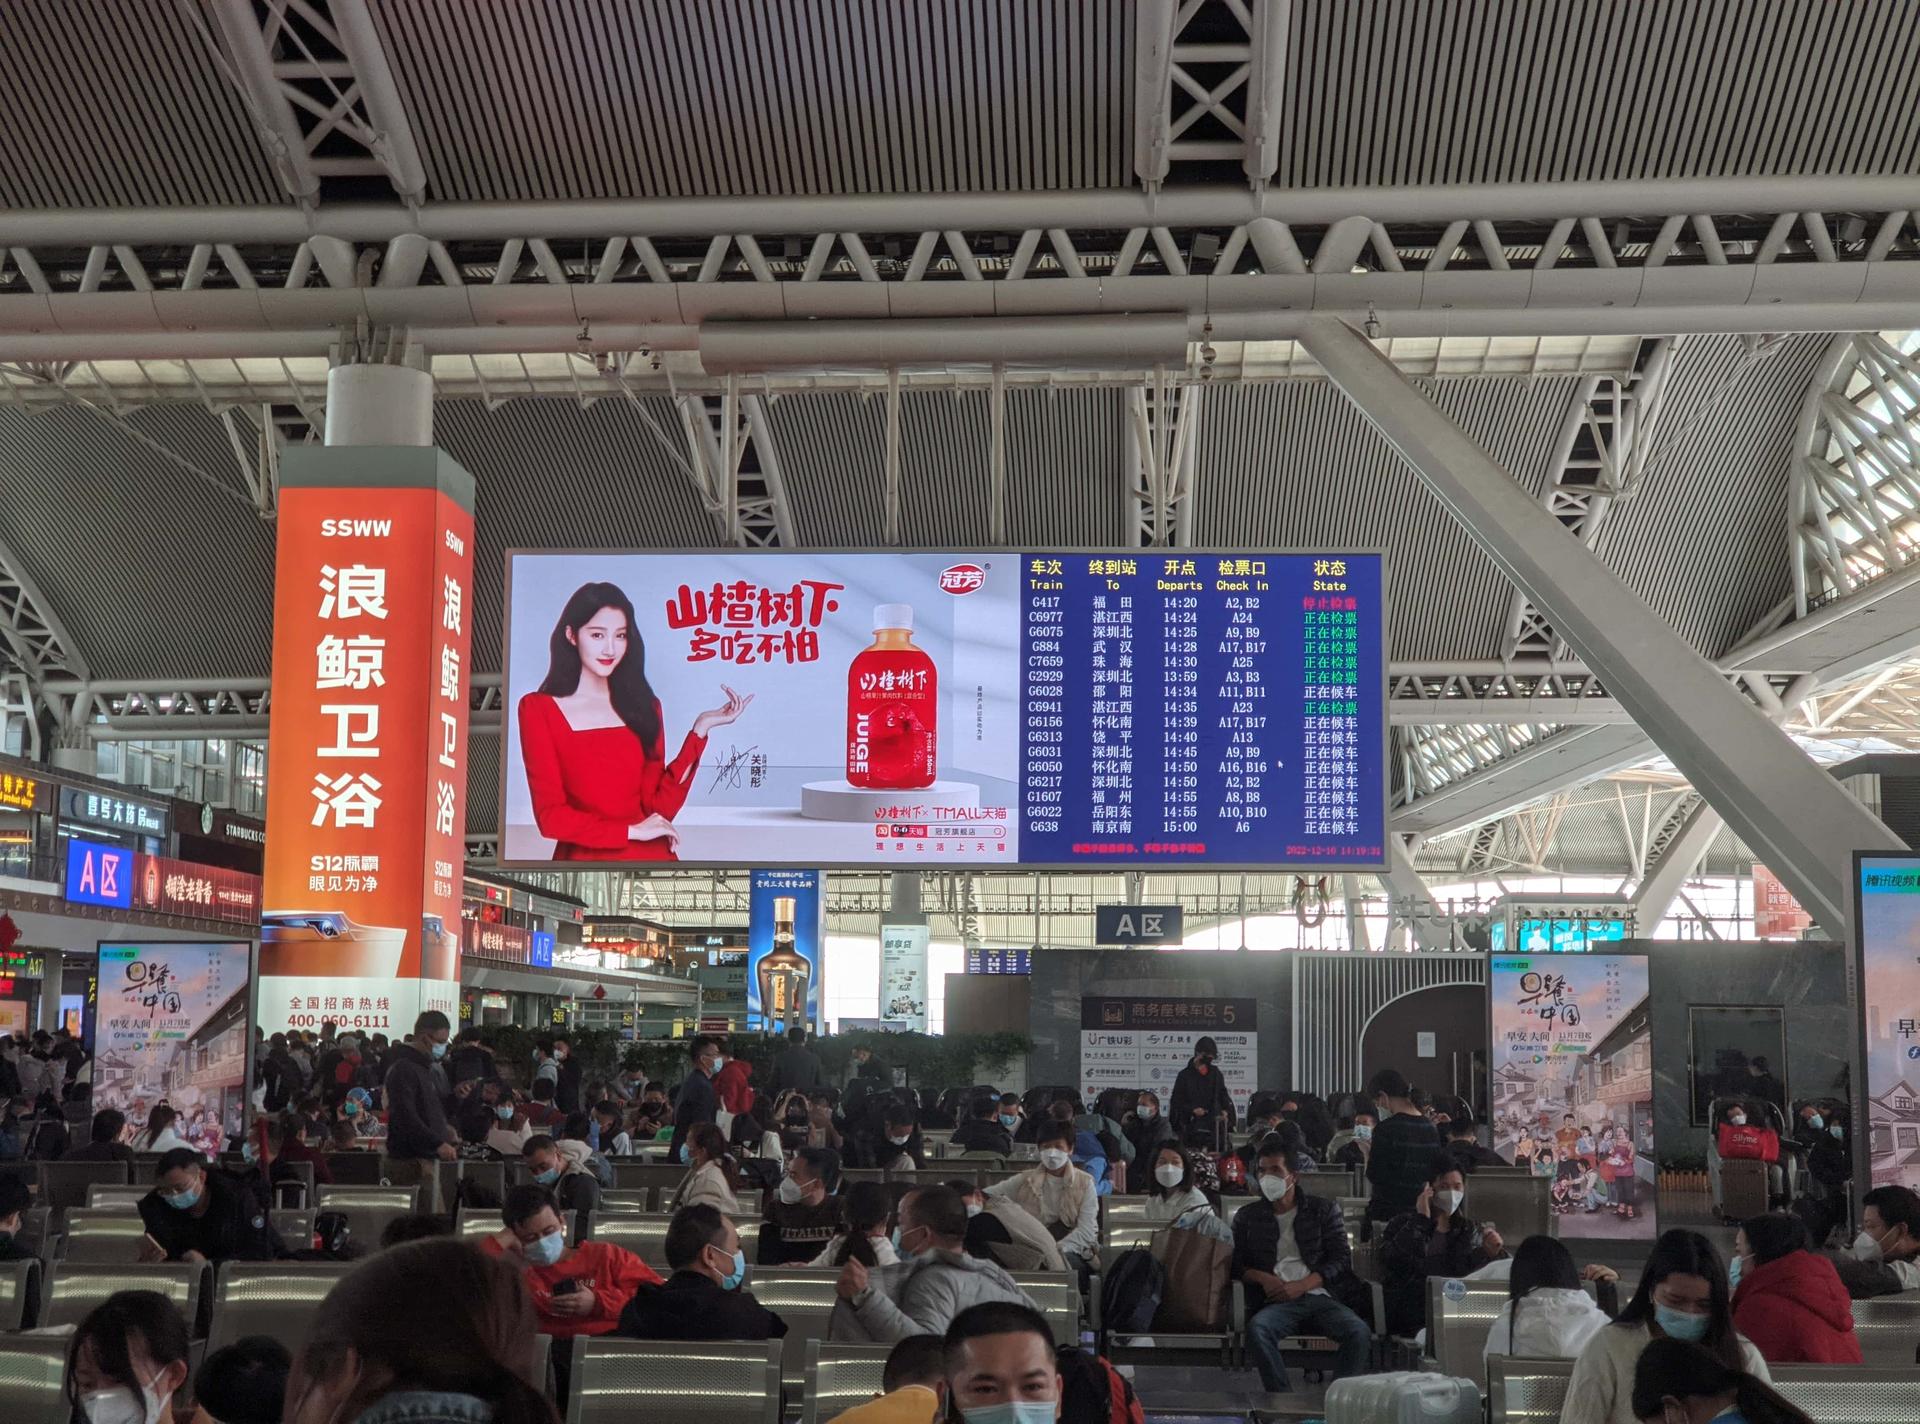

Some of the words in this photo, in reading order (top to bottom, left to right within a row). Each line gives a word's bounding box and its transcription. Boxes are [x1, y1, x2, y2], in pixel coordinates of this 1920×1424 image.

[321, 519, 391, 537] SSWW
[445, 529, 464, 557] SSWW
[1031, 559, 1062, 575] 车次
[1089, 560, 1136, 575] 终到站
[1164, 560, 1196, 575] 开点
[1219, 560, 1265, 576] 检票口
[1314, 560, 1346, 576] 状态
[941, 571, 983, 588] 冠芳
[1031, 580, 1062, 589] Train
[1107, 580, 1119, 589] To
[1217, 580, 1249, 590] Check
[1257, 581, 1268, 590] In
[1158, 580, 1202, 591] Departs
[1314, 581, 1346, 591] State
[666, 581, 844, 629] 山楂树下
[1033, 597, 1059, 607] G417
[1165, 598, 1197, 608] 14:20
[1029, 612, 1063, 622] C6977
[1165, 612, 1196, 622] 14:24
[1232, 613, 1252, 623] A24
[1304, 612, 1357, 627] 正在检票
[1029, 627, 1063, 636] G6075
[1165, 627, 1197, 637] 14:25
[1304, 626, 1357, 642] 正在检票
[687, 628, 819, 664] 多吃不怕
[1033, 641, 1059, 651] G884
[1165, 642, 1197, 652] 14:28
[1304, 641, 1357, 657] 正在检票
[1029, 656, 1063, 666] C7659
[1165, 657, 1197, 667] 14:30
[1233, 657, 1253, 667] A25
[1304, 656, 1357, 672] 正在检票
[1029, 671, 1063, 681] G2929
[1165, 671, 1197, 681] 13:59
[1304, 671, 1357, 687] 正在检票
[311, 564, 388, 828] 浪鲸卫浴
[1029, 686, 1062, 696] G6028
[1165, 686, 1197, 697] 14:34
[1304, 686, 1357, 702] 正在候车
[436, 573, 462, 837] 浪鲸卫浴
[1029, 702, 1061, 712] C6941
[1165, 702, 1197, 712] 14:35
[1232, 702, 1253, 712] A23
[1304, 701, 1357, 717] 正在检票
[1029, 717, 1062, 727] G6156
[1165, 717, 1197, 727] 14:39
[1304, 716, 1358, 729] 正在候车
[1028, 732, 1062, 742] G6313
[1165, 732, 1197, 742] 14:40
[1233, 732, 1253, 742] A13
[1304, 731, 1358, 744] 正在候车
[1028, 747, 1061, 756] G6031
[1165, 747, 1197, 757] 14:45
[1304, 746, 1358, 759] 正在候车
[751, 754, 761, 788] 关晓彤
[1028, 761, 1062, 772] G6050
[1165, 762, 1197, 772] 14:50
[1304, 761, 1358, 774] 正在候车
[0, 773, 35, 798] 特产汇
[1028, 777, 1062, 786] G6217
[1165, 777, 1197, 787] 14:50
[1304, 776, 1358, 789] 正在候车
[1028, 791, 1061, 801] G1607
[1164, 792, 1197, 802] 14:55
[1304, 791, 1358, 804] 正在候车
[1028, 807, 1061, 817] G6022
[1164, 807, 1197, 817] 14:55
[1304, 806, 1358, 820] 正在候车
[1031, 822, 1058, 831] G638
[1164, 821, 1197, 832] 15:00
[1236, 822, 1249, 832] A6
[1304, 821, 1359, 835] 正在候车
[226, 824, 258, 842] STARBUCKS
[876, 843, 1006, 851] 理想生活上天猫
[311, 855, 379, 872] S12脉霸
[80, 850, 120, 897] A区
[309, 875, 378, 892] 眼见为净
[1115, 913, 1165, 937] A区
[28, 958, 44, 976] A17
[289, 997, 389, 1010] 全国招商热线
[1132, 1003, 1216, 1017] 商务座候车区
[1223, 1005, 1236, 1024] 5
[288, 1014, 389, 1028] 400-060-6111
